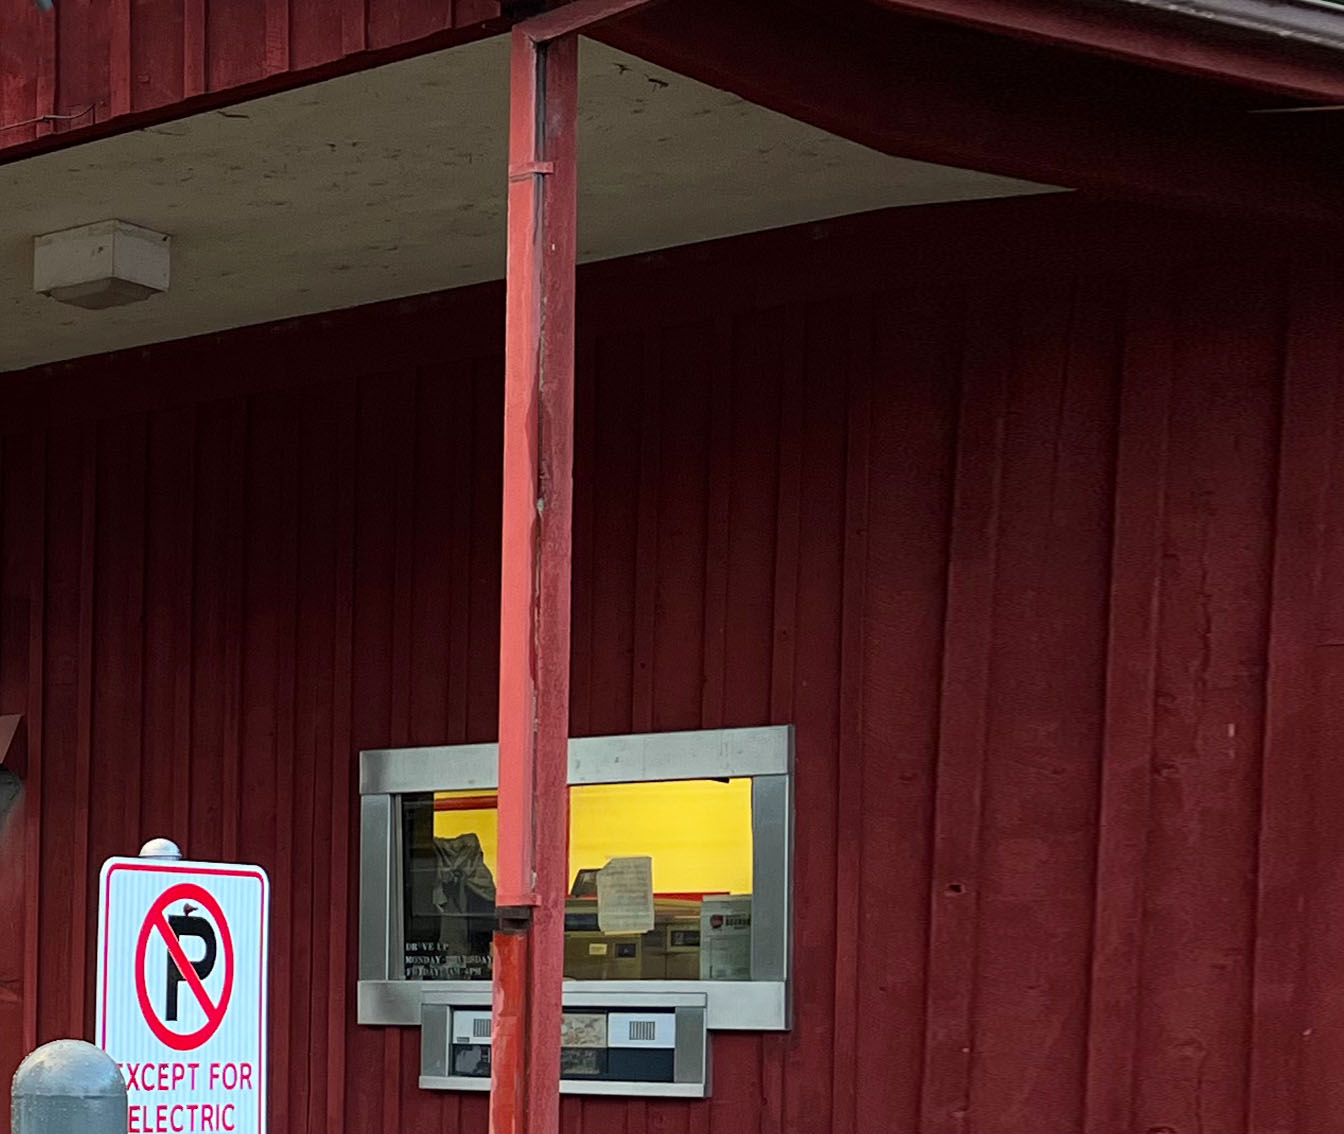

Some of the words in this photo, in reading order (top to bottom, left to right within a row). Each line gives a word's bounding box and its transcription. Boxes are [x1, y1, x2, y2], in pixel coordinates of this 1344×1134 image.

[117, 1063, 200, 1091] XCEPT
[209, 1063, 253, 1090] FOR
[129, 1104, 235, 1133] ELECTRIC
